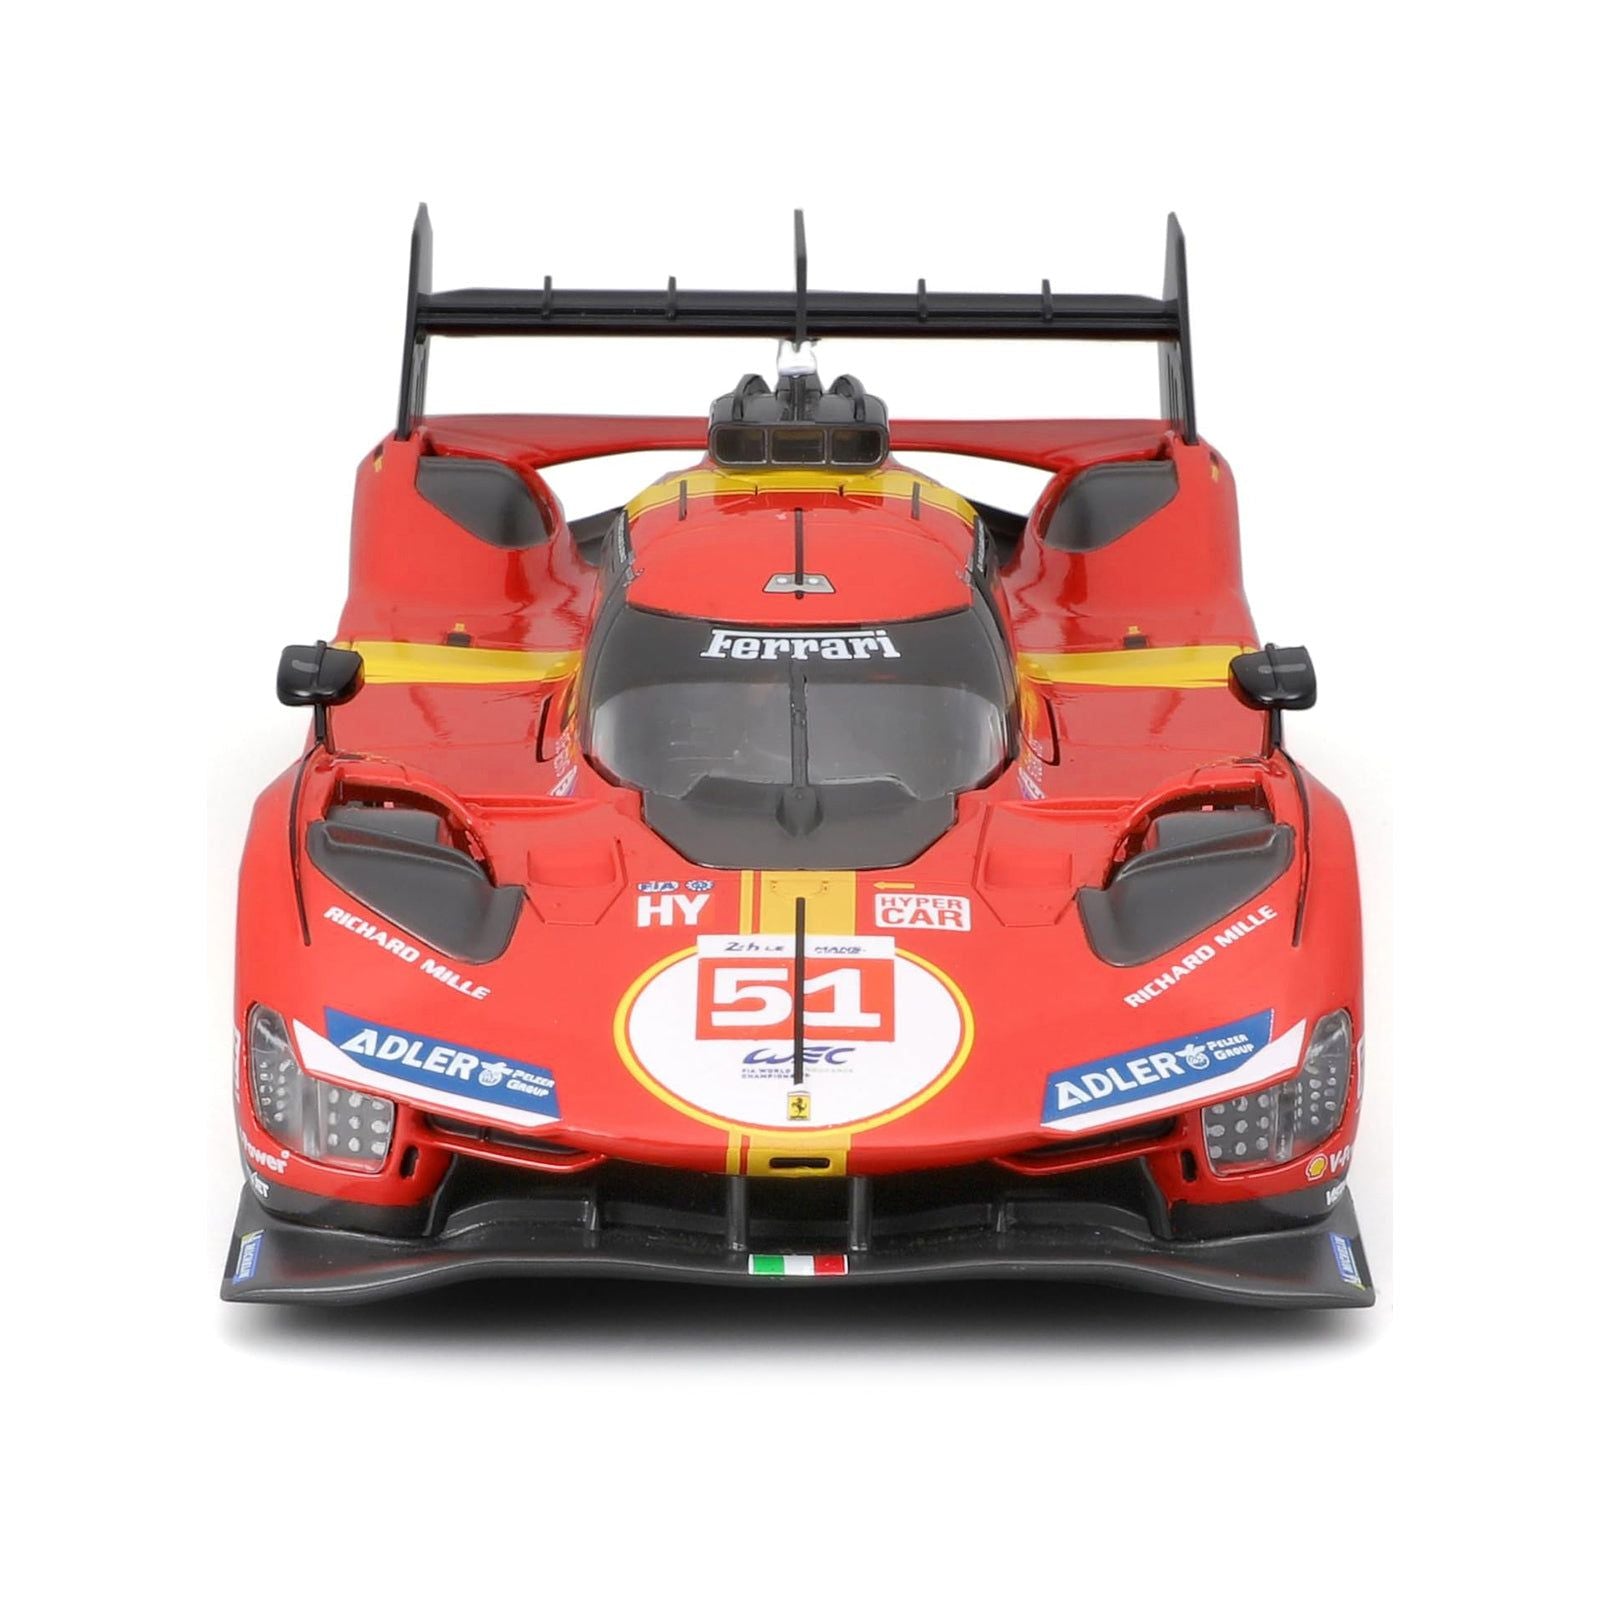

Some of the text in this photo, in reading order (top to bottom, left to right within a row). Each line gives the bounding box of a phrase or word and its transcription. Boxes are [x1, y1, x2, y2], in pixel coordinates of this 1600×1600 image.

[700, 629, 901, 660] Ferrari
[640, 882, 675, 891] FIA
[637, 894, 710, 927] HY
[880, 897, 963, 910] HYPER
[881, 908, 964, 928] CAR
[323, 906, 491, 1000] RICHARD MILLE
[1123, 905, 1278, 1008] RICHARD MILLE
[711, 967, 881, 1028] 51
[1206, 1034, 1249, 1051] PELZER
[1213, 1043, 1255, 1061] GROUP
[339, 1027, 479, 1081] ADLER
[742, 1046, 856, 1065] WEC
[506, 1079, 550, 1098] GROUP
[512, 1069, 555, 1088] PELZER
[1055, 1051, 1186, 1110] ADLER
